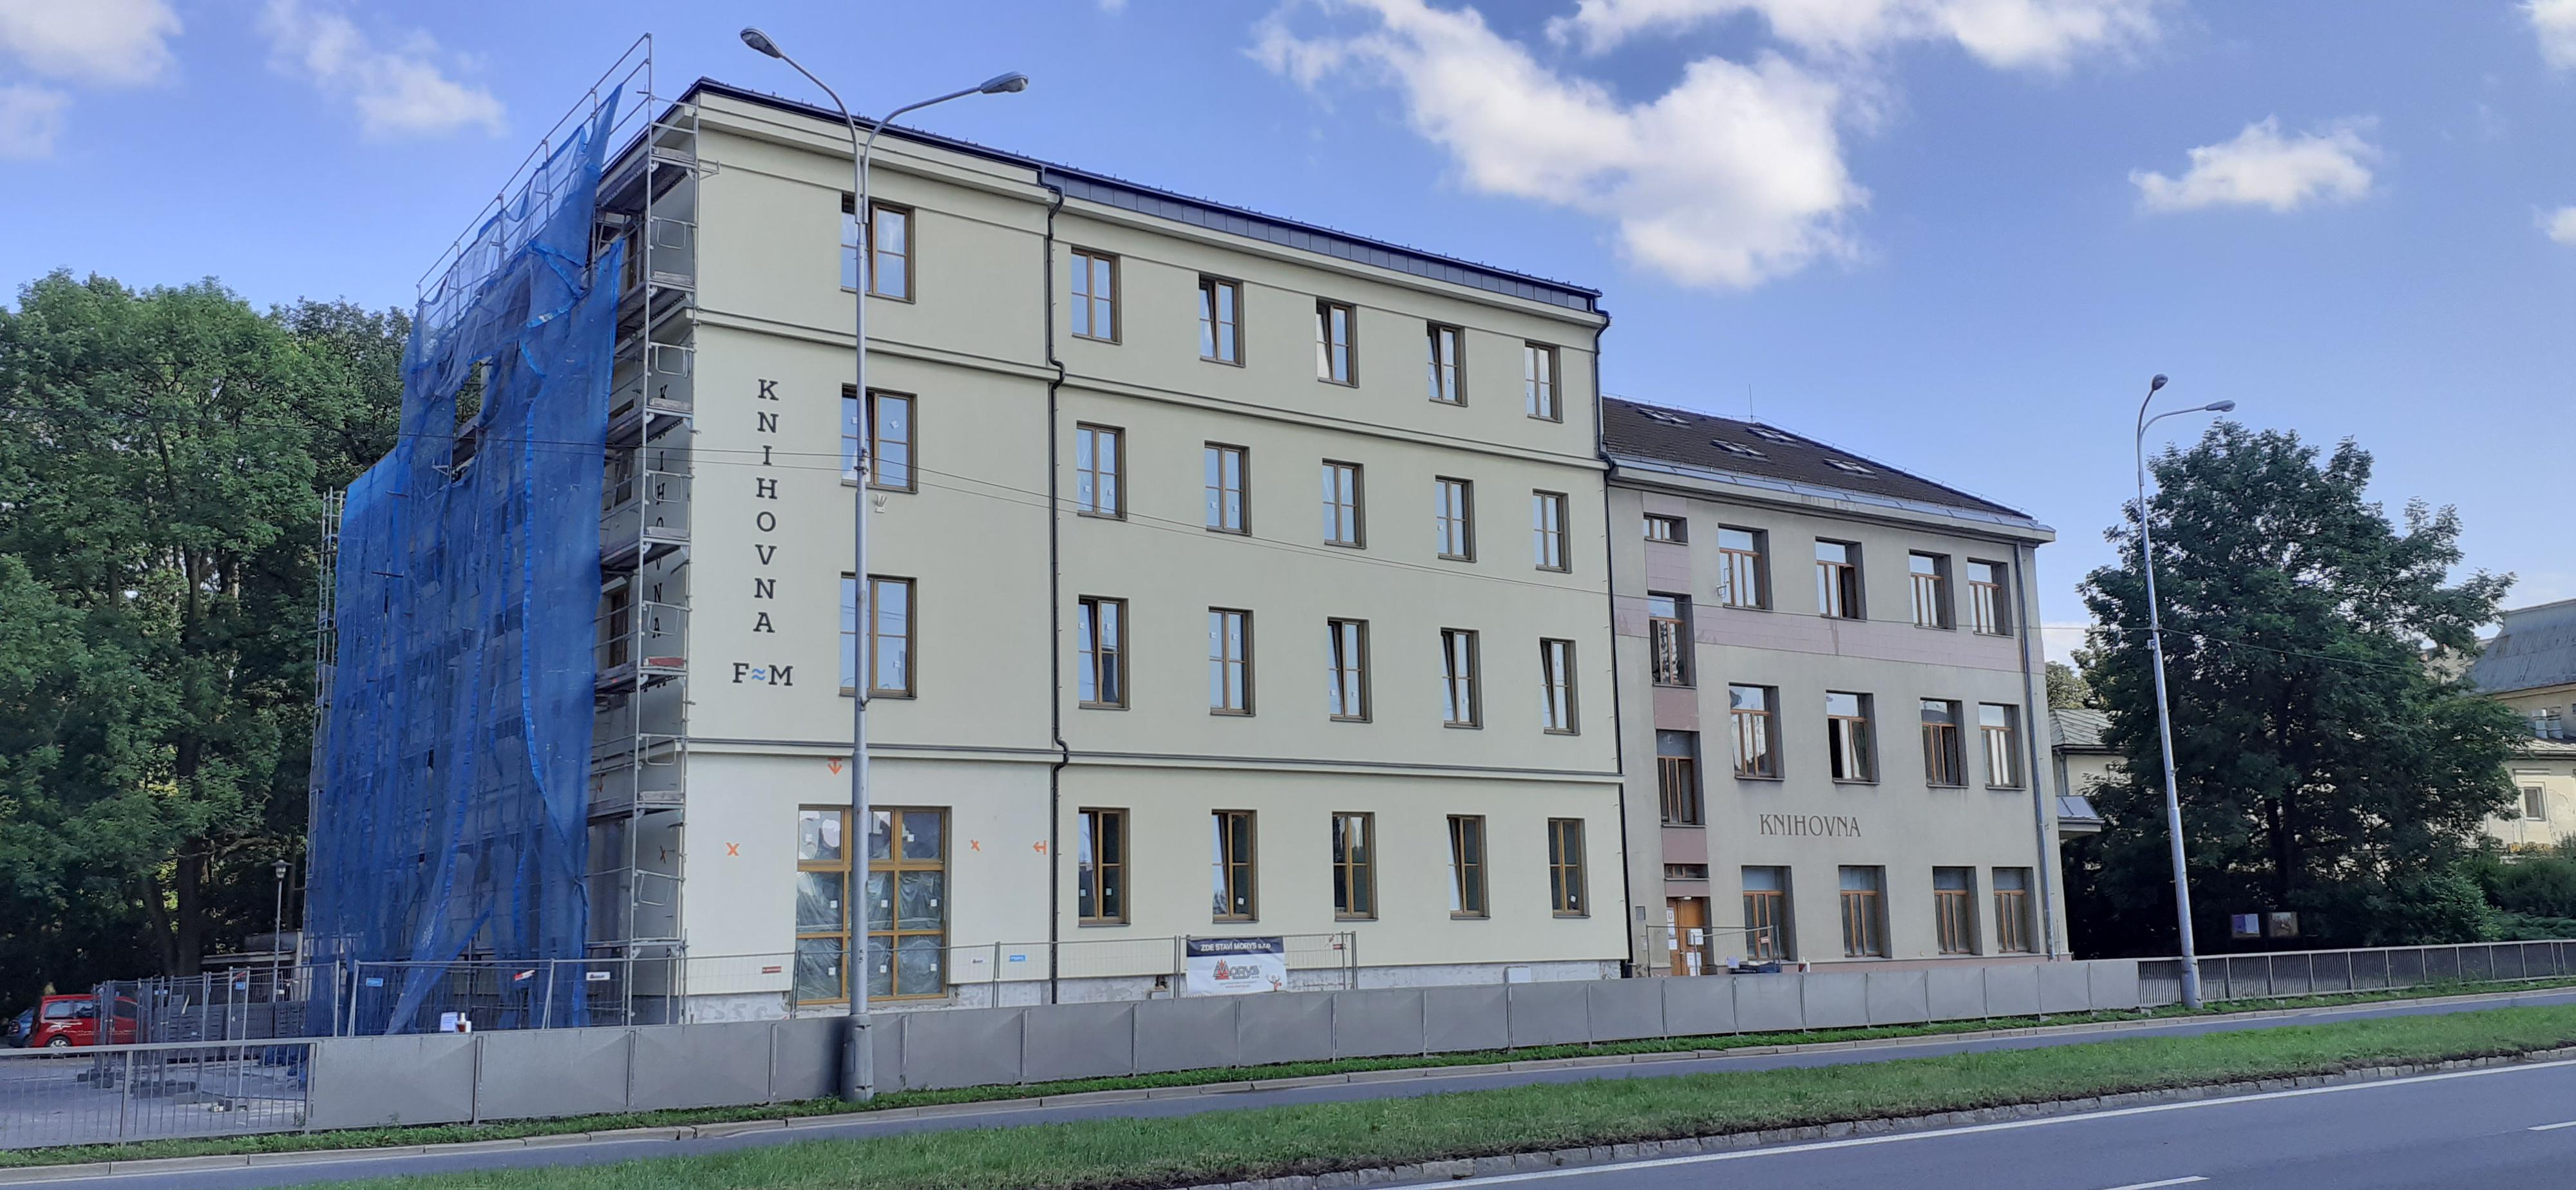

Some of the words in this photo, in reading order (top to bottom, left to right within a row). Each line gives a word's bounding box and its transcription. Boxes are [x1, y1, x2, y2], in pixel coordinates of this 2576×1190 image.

[752, 378, 779, 634] KNIHOVNA
[1759, 813, 1861, 837] KNIHOVNA
[1200, 943, 1215, 952] ZDE
[1215, 941, 1233, 951] STAVÍ
